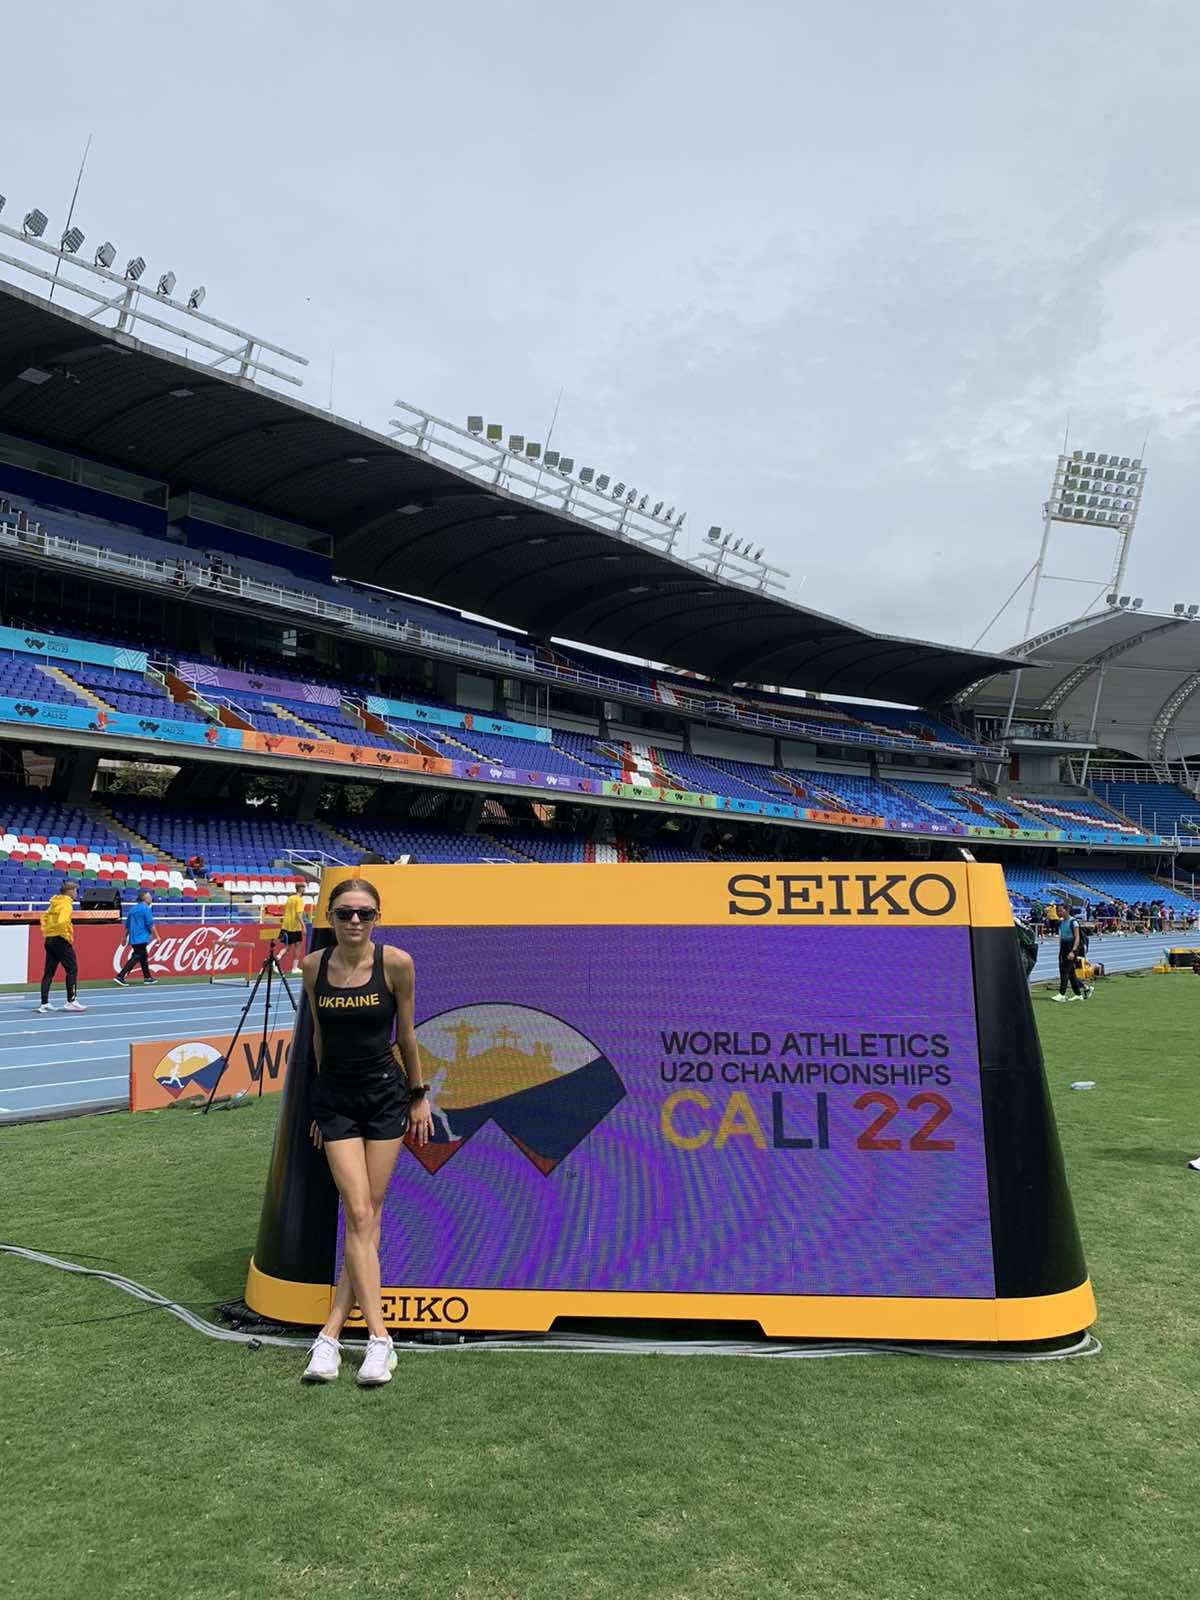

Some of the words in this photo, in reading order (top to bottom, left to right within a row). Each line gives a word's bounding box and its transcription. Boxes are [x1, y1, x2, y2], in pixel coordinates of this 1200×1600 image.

[727, 873, 956, 916] SEIKO
[319, 993, 380, 1008] UKRAINE
[243, 1040, 291, 1081] W
[660, 1031, 771, 1056] WORLD
[780, 1032, 950, 1057] ATHLETICS
[660, 1061, 713, 1083] U20
[721, 1061, 951, 1086] CHAMPIONSHIPS
[660, 1089, 830, 1150] CALI
[853, 1091, 955, 1151] 22
